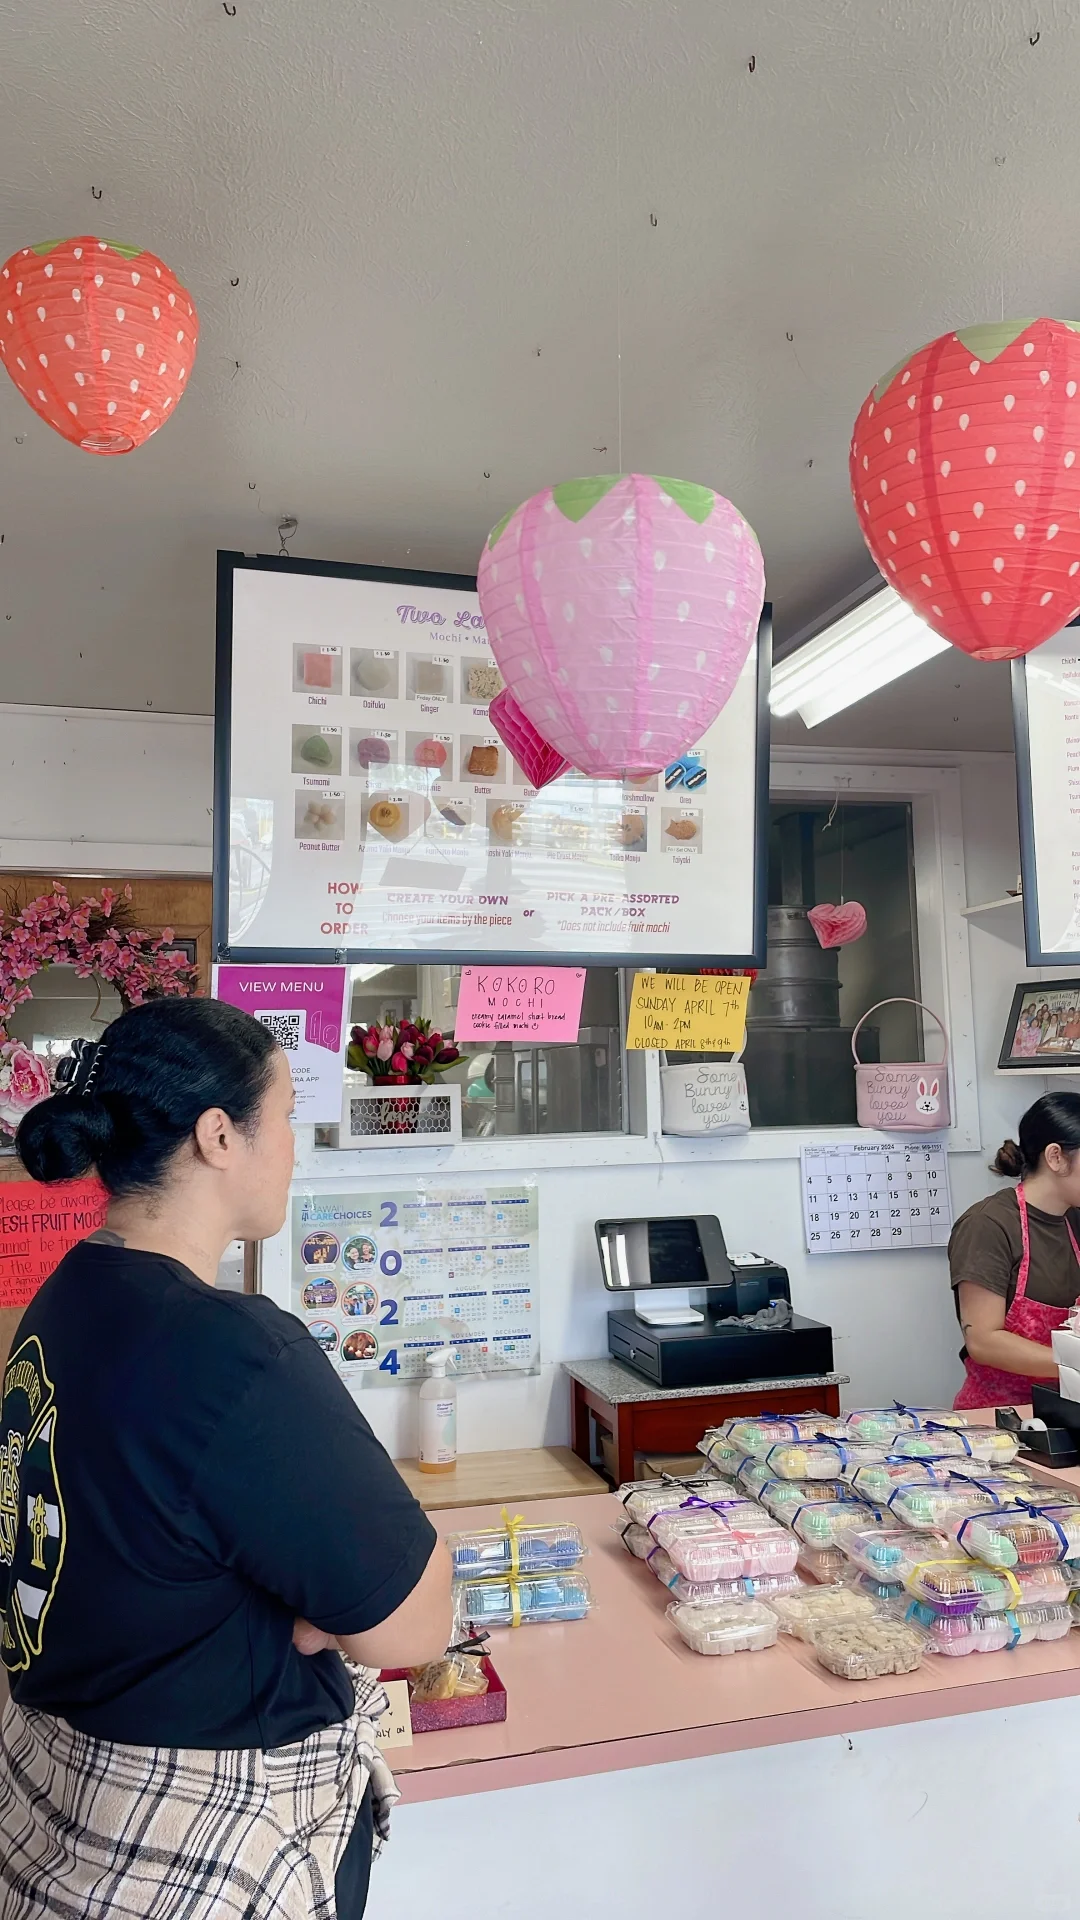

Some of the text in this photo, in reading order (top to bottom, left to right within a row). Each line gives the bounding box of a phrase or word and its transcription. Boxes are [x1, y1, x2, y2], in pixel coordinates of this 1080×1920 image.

[396, 605, 446, 625] Two
[430, 632, 461, 642] Mochi
[308, 696, 327, 706] Chichi
[363, 700, 386, 710] Daifuku
[420, 704, 439, 715] Ginger
[302, 777, 330, 787] Tsumami
[474, 786, 492, 795] Butter
[300, 842, 340, 852] Peanut Butter
[328, 882, 363, 895] HOW
[387, 893, 508, 905] CREATE YOUR OWN
[547, 891, 574, 902] PICK
[581, 892, 589, 902] A
[336, 903, 353, 915] TO
[523, 908, 534, 917] or
[437, 912, 460, 925] items
[462, 912, 473, 927] by
[474, 913, 488, 925] the
[489, 914, 512, 926] piece
[583, 921, 597, 932] not
[598, 920, 627, 932] include
[629, 921, 644, 933] fruit
[646, 922, 670, 933] mochi
[320, 922, 368, 935] ORDER
[239, 982, 324, 992] VIEW MENU
[478, 976, 555, 995] KOKORO
[641, 976, 743, 995] WE WILL BE OPEN
[488, 997, 543, 1008] MOCHI
[636, 996, 740, 1017] SUNDAY APRIL 7th
[674, 1018, 690, 1032] 2PM
[634, 1038, 668, 1048] CLOSED
[675, 1039, 696, 1049] APRIL
[697, 1066, 738, 1083] Some
[874, 1066, 920, 1083] Some
[684, 1083, 732, 1099] Bunny
[866, 1080, 910, 1099] Bunny
[692, 1098, 731, 1114] loves
[869, 1094, 909, 1111] loves
[381, 1101, 418, 1125] love
[877, 1110, 907, 1125] you
[703, 1114, 730, 1129] you
[905, 1154, 911, 1162] 2
[924, 1153, 932, 1162] 3
[808, 1176, 812, 1185] 4
[828, 1176, 832, 1184] 5
[846, 1174, 852, 1183] 6
[866, 1174, 872, 1182] 7
[906, 1172, 913, 1180] 9
[928, 1170, 937, 1179] 10
[40, 1194, 55, 1209] be
[61, 1194, 100, 1208] aware
[828, 1194, 839, 1202] 12
[848, 1192, 858, 1201] 13
[890, 1190, 899, 1199] 15
[908, 1190, 919, 1198] 16
[928, 1188, 938, 1197] 17
[310, 1211, 372, 1220] CARECHOICES
[810, 1208, 940, 1222] 18 19 20 21 22 23 24
[32, 1213, 70, 1233] FRUIT
[810, 1228, 902, 1241] 25 26 27 28 29
[40, 1237, 55, 1252] be
[11, 1260, 32, 1275] the
[10, 1288, 32, 1296] FRUIT
